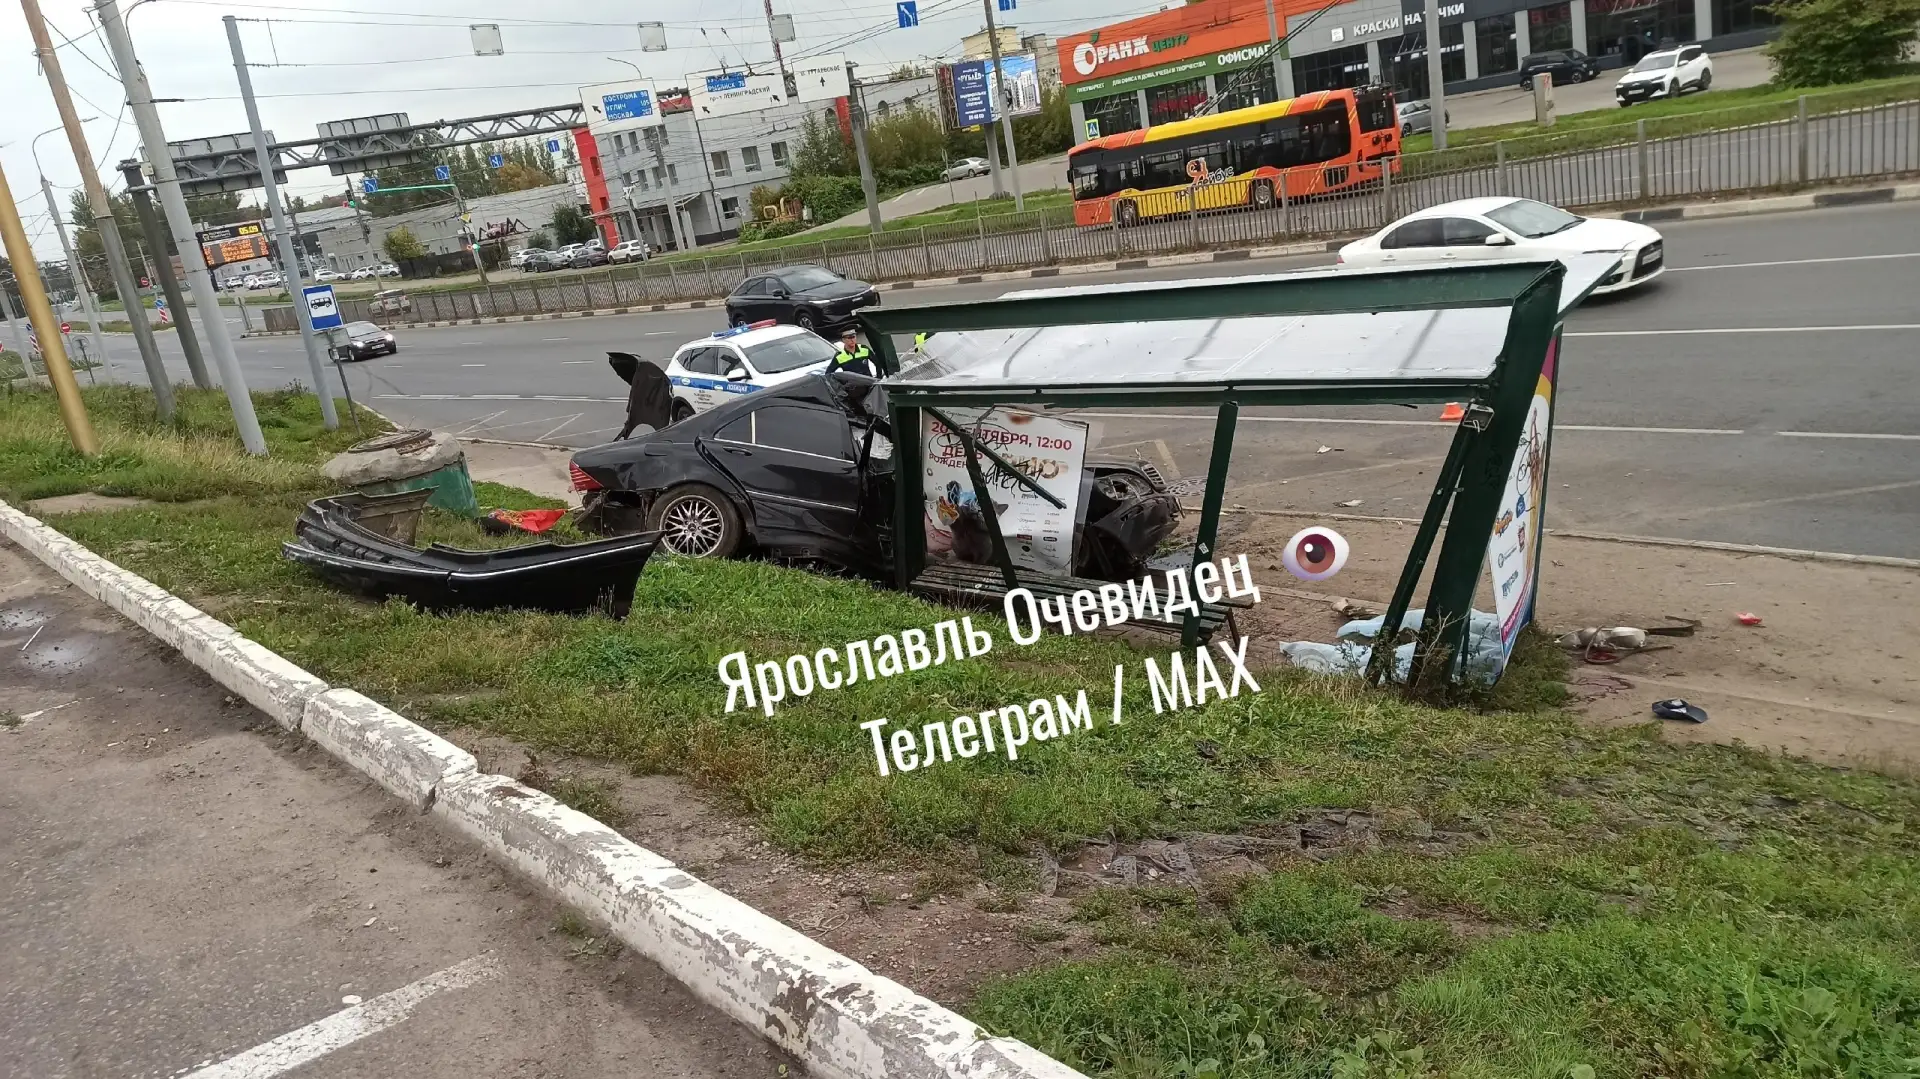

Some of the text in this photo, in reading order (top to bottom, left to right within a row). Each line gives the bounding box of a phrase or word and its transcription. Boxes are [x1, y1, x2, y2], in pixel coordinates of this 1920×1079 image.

[1353, 17, 1399, 37] КРАСКИ
[1404, 12, 1422, 26] НА
[1073, 33, 1189, 76] ОРАНЖ ЦЕНТР
[1217, 44, 1271, 66] ОФИСМАГ
[603, 93, 638, 103] КОСТРОМА
[606, 103, 627, 111] УГЛИЧ
[608, 112, 635, 120] МОСКВА
[1036, 436, 1073, 451] 12:00
[942, 445, 984, 461] ДЕЬ
